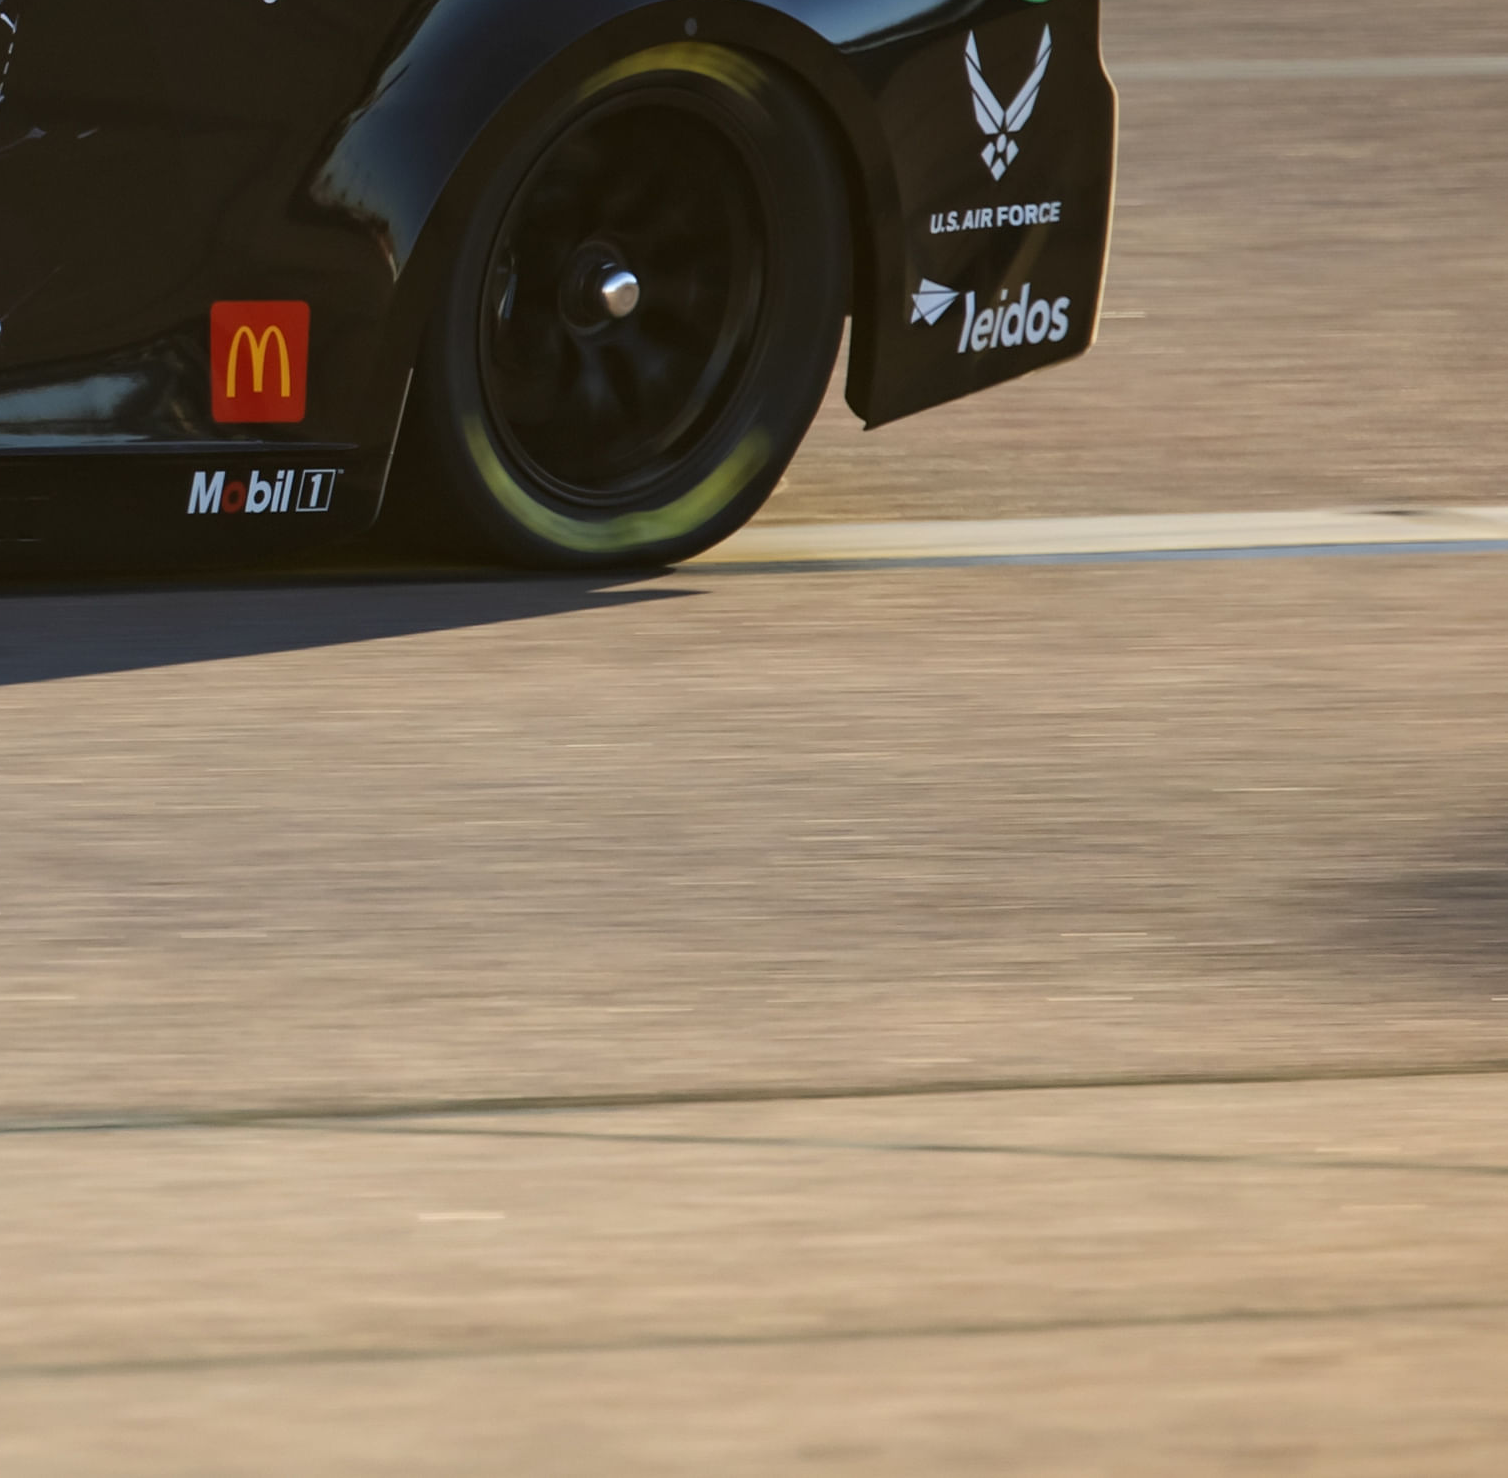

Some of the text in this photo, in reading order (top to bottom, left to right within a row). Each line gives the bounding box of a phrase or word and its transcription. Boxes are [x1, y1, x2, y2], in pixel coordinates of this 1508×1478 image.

[930, 201, 1062, 235] U.S. AIR FORCE
[957, 282, 1072, 354] leidos
[187, 469, 293, 515] Mobil
